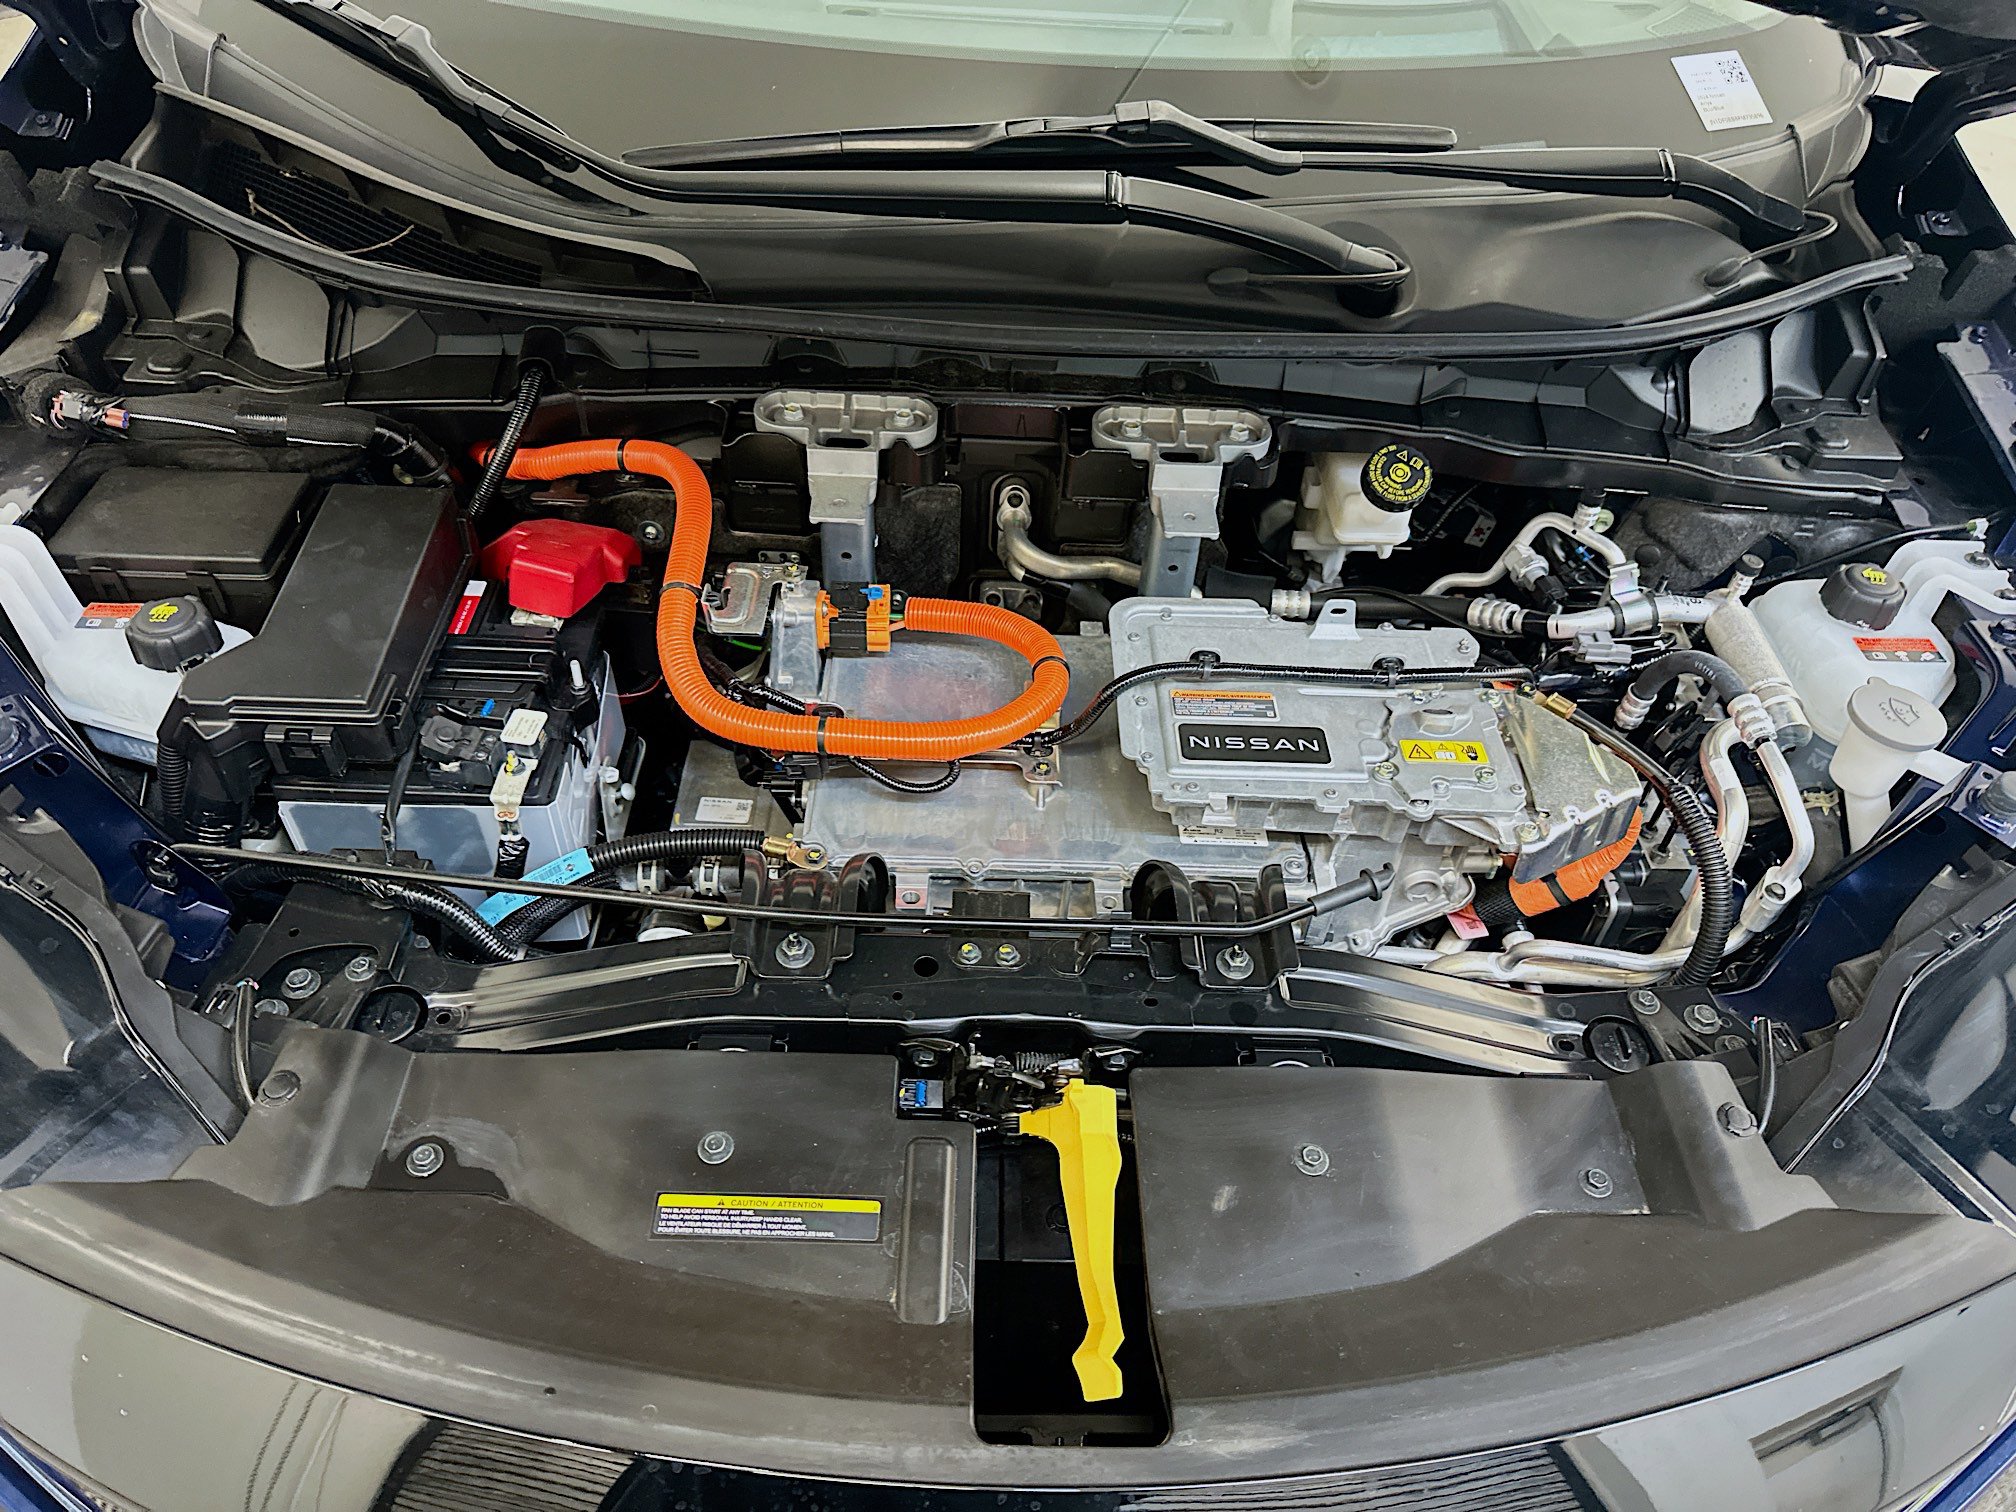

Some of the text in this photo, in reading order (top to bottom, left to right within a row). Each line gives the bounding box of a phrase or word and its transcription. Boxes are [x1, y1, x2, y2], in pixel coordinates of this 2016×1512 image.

[1188, 735, 1320, 752] NISSAN
[777, 1200, 824, 1208] ATTENTION
[674, 1226, 693, 1234] ÉVITER
[733, 1222, 762, 1230] DÉMARRER
